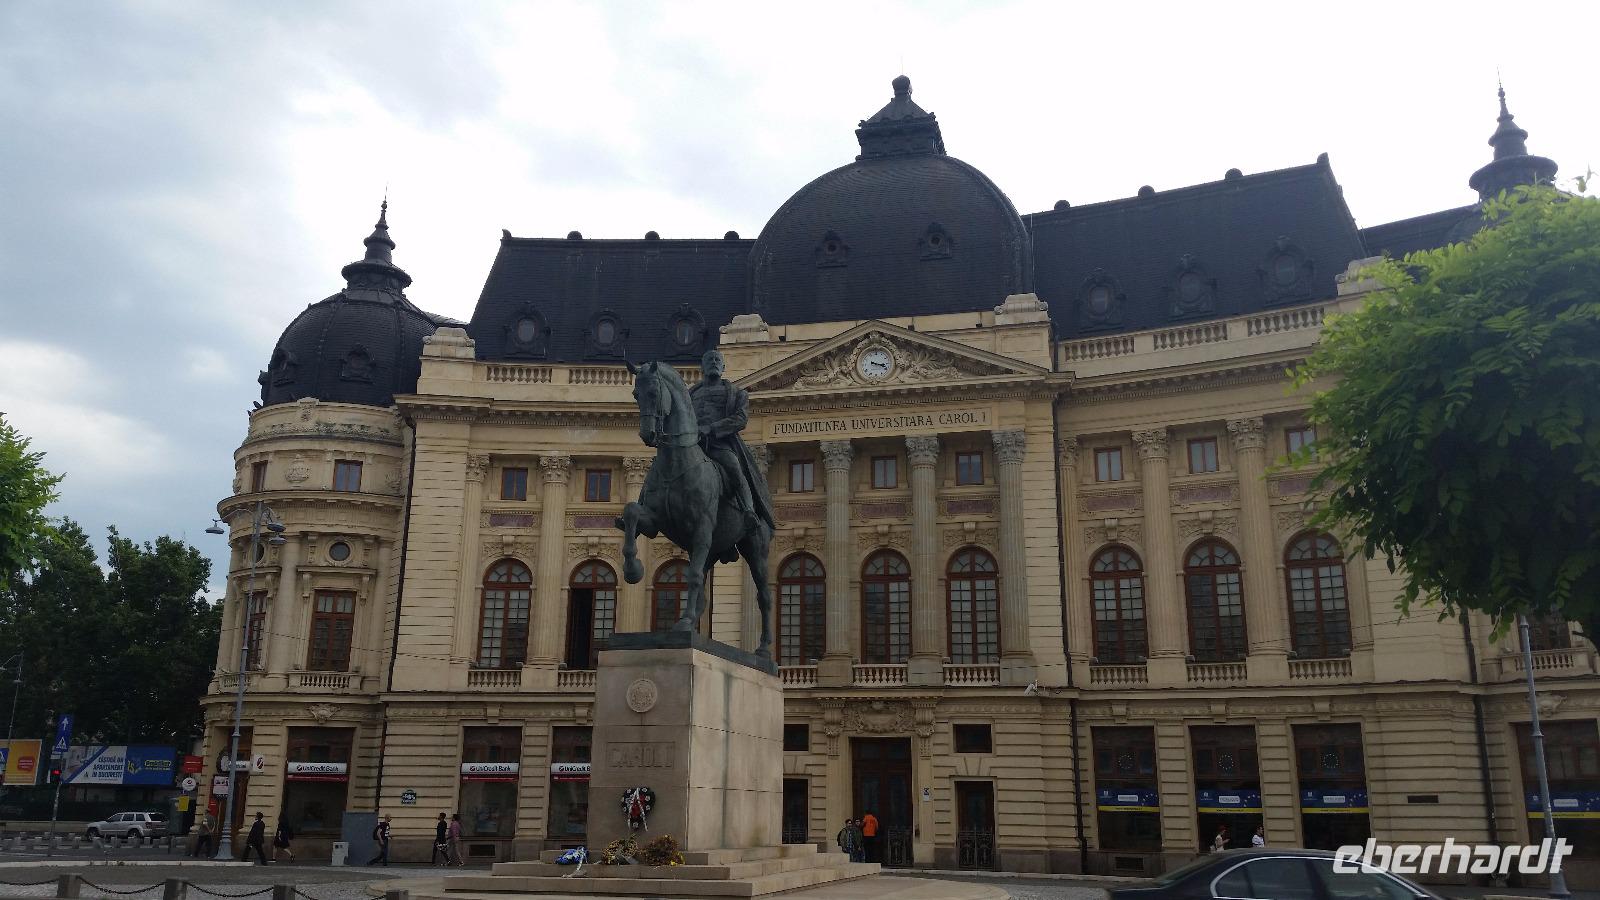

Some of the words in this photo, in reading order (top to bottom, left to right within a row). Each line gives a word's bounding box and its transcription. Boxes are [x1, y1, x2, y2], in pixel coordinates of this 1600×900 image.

[773, 419, 848, 435] FUNDATIUNEA
[851, 415, 934, 430] UNIVERSITARA
[938, 411, 978, 425] CAROL
